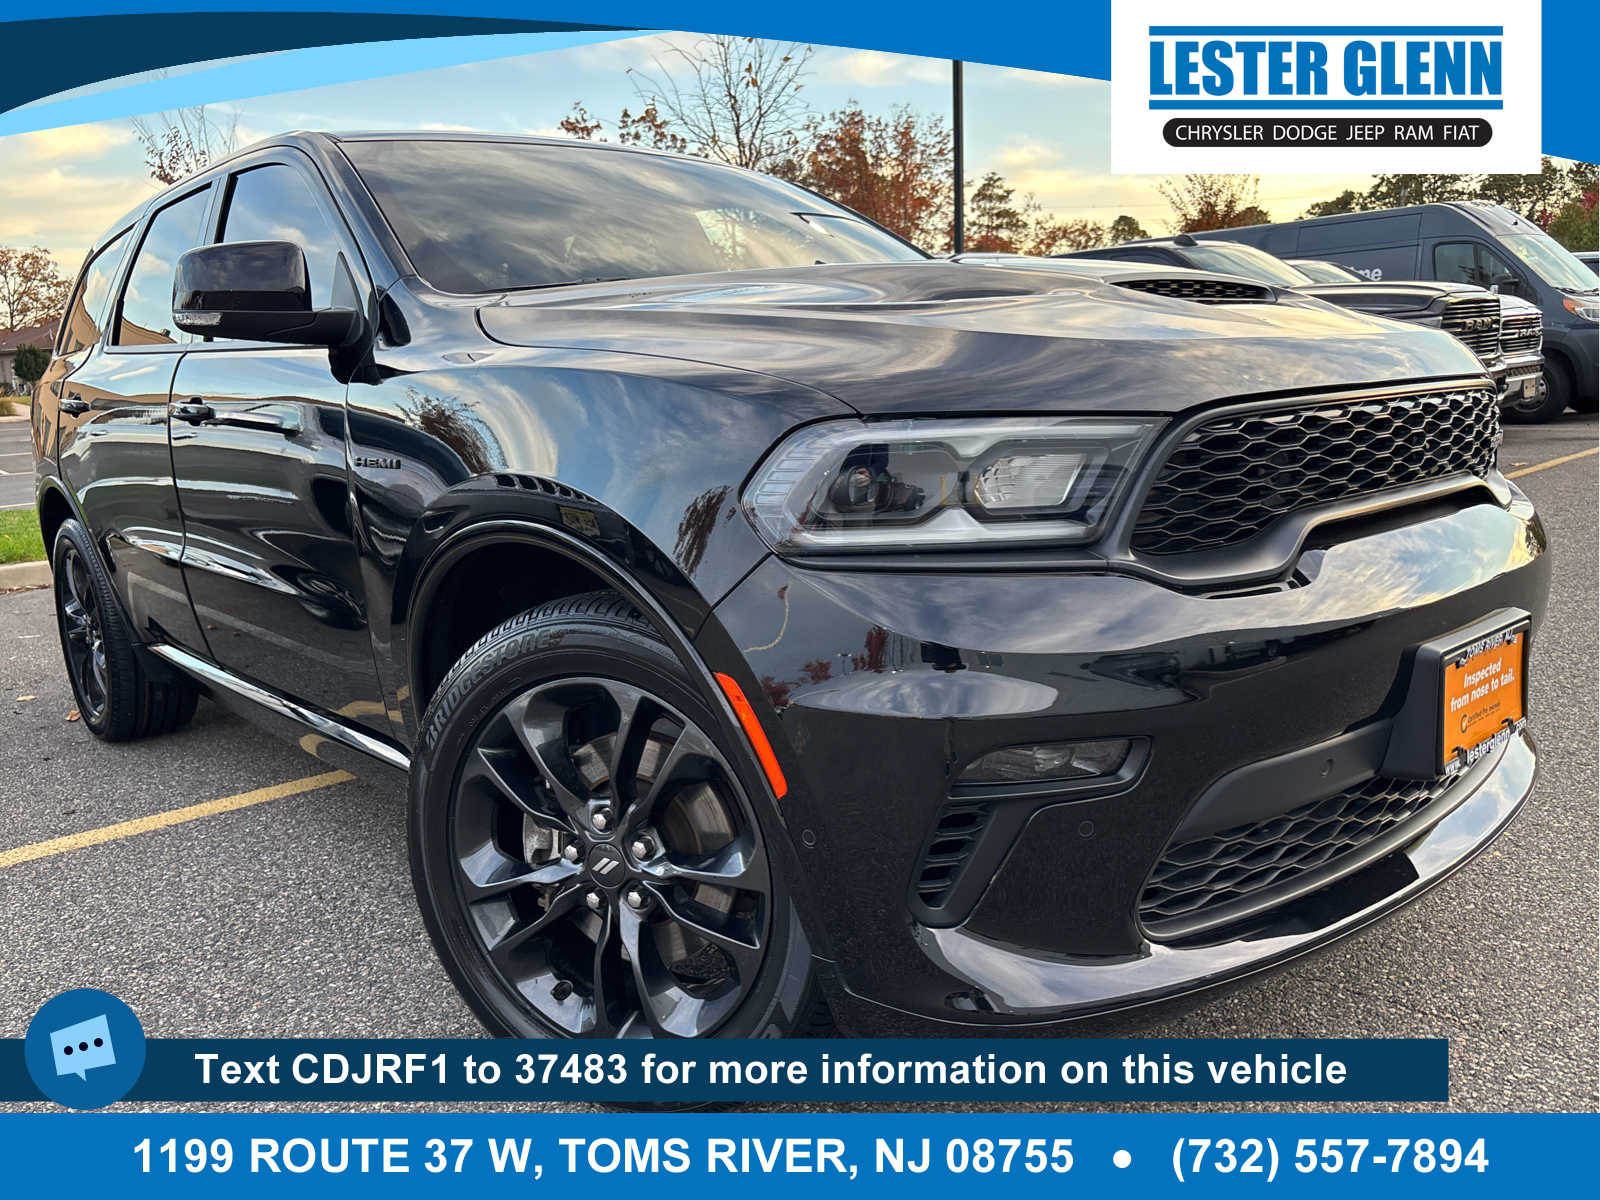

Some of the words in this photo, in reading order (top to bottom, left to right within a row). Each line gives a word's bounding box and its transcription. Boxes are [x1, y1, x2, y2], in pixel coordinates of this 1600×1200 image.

[354, 456, 401, 469] HEMI
[425, 629, 554, 750] BRIDGESTONE
[1450, 693, 1470, 712] from
[1471, 683, 1489, 702] nose
[1491, 678, 1499, 692] to
[1500, 667, 1515, 687] tail.
[1464, 656, 1502, 688] Inspected
